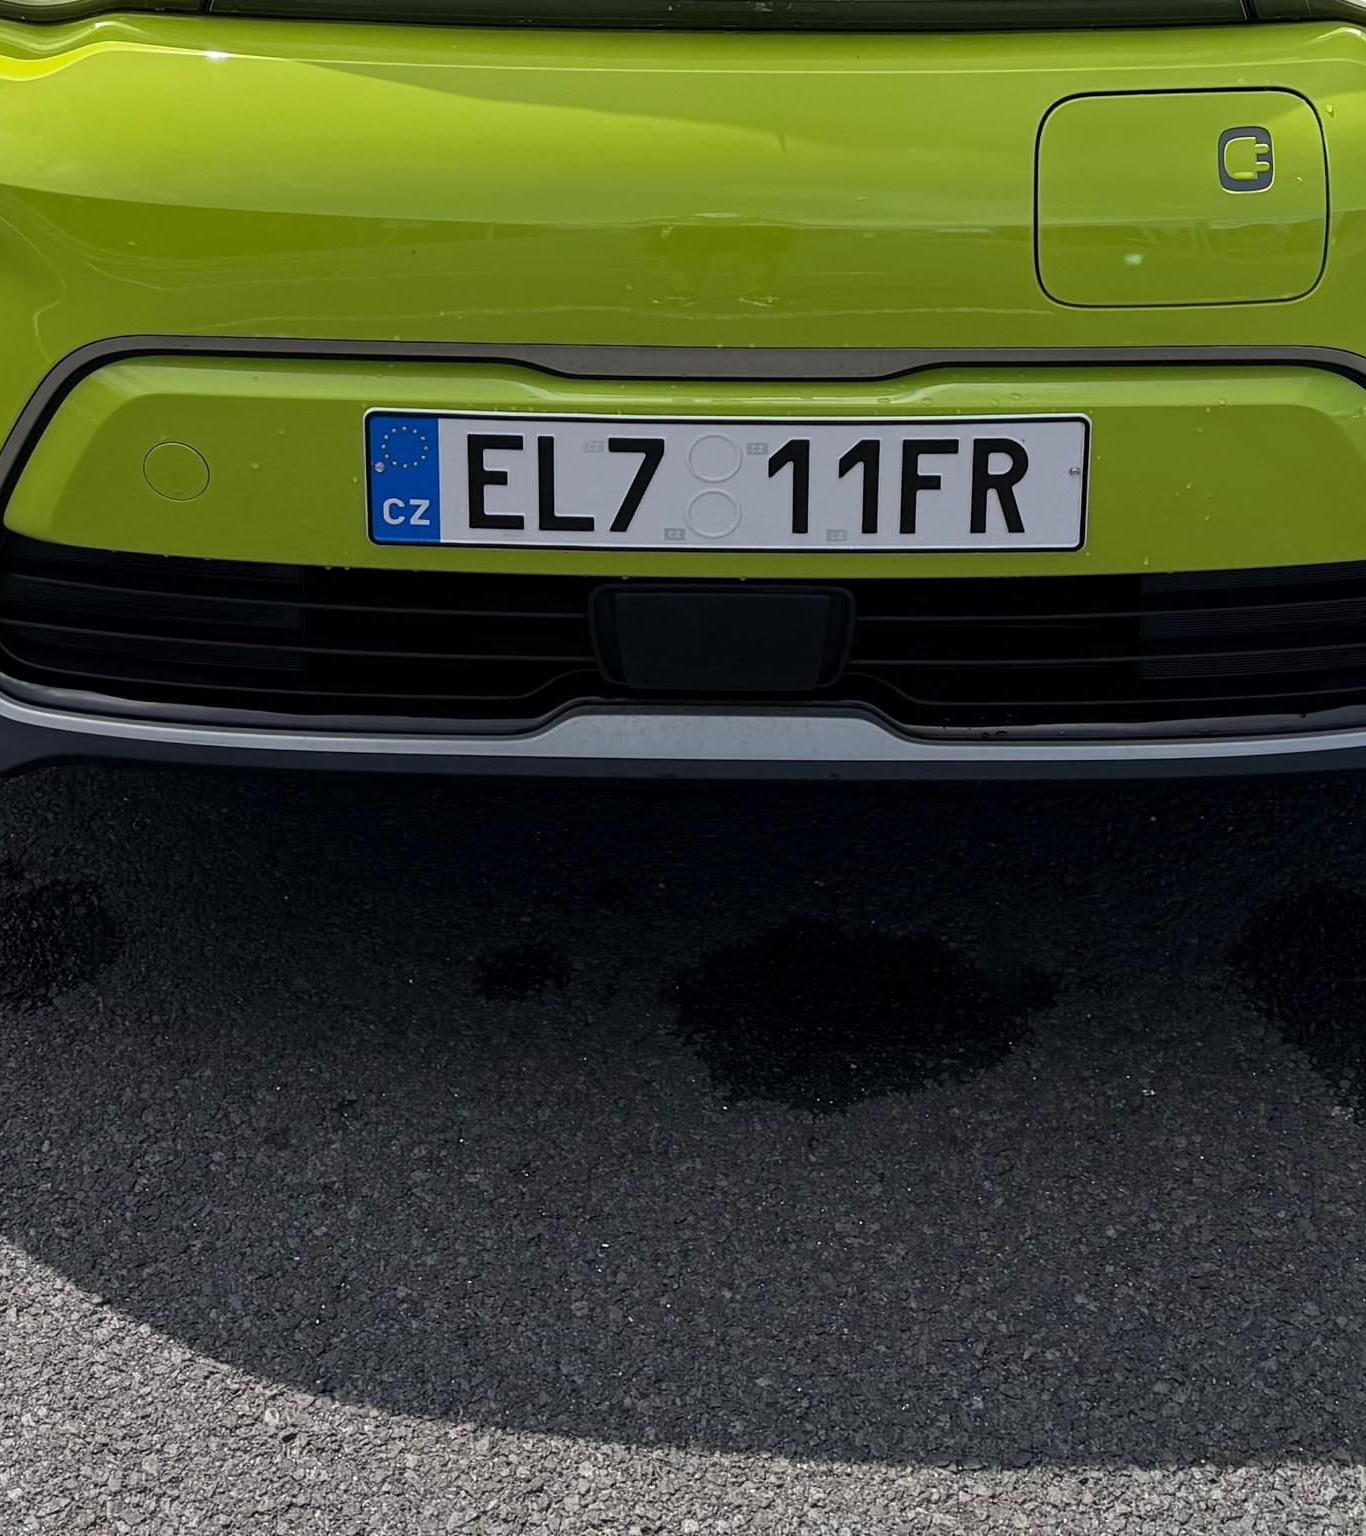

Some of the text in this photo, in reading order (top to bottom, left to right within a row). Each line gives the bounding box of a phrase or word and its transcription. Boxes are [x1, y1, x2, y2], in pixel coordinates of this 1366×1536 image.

[382, 497, 431, 526] CZ
[466, 433, 1029, 535] EL7 11FR
